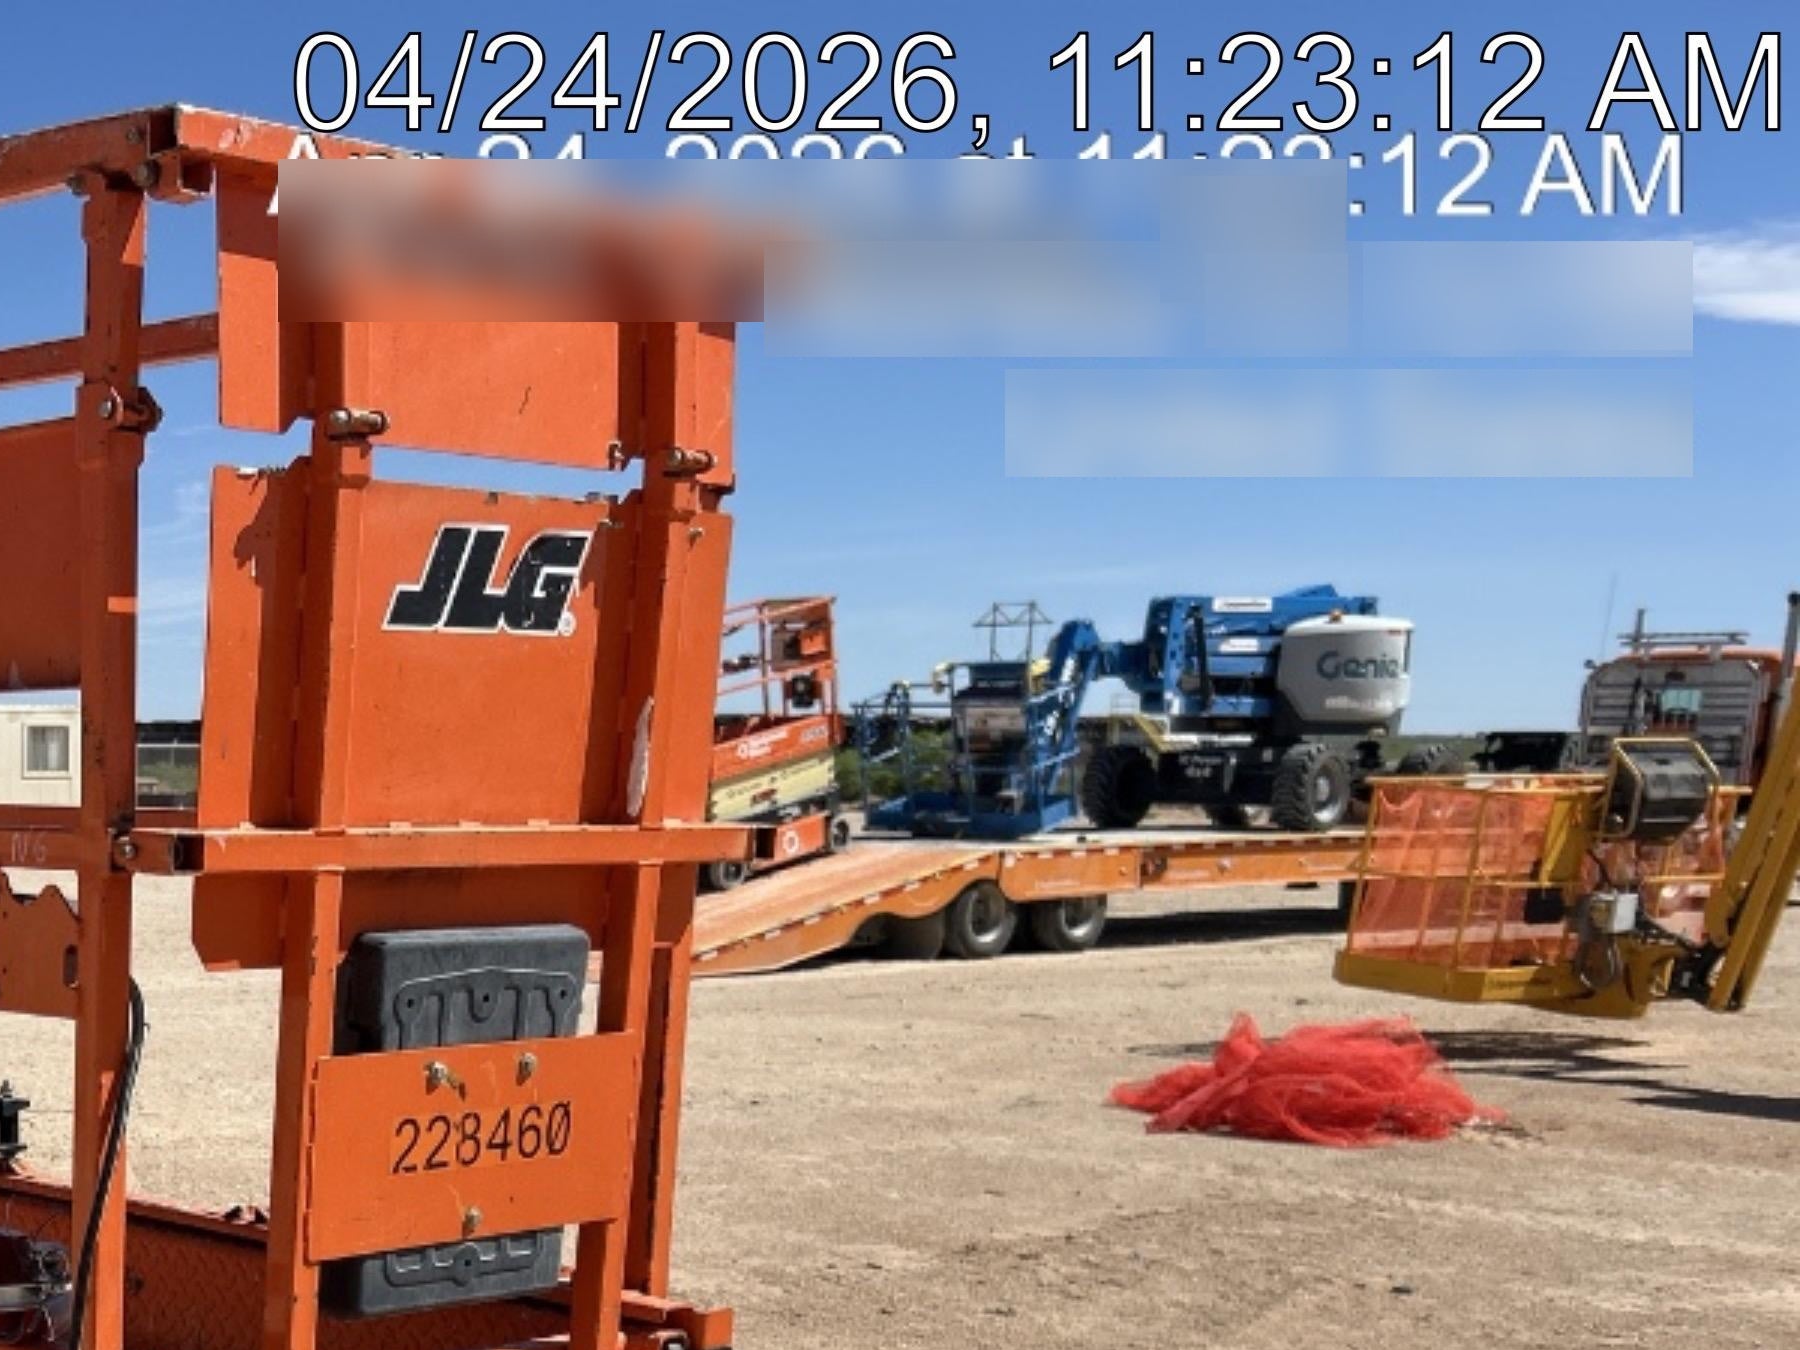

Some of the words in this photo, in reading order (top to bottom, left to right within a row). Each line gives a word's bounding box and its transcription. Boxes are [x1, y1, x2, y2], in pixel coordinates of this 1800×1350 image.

[381, 519, 595, 637] JLG
[1317, 649, 1400, 681] Genie
[392, 1100, 571, 1175] 228460
